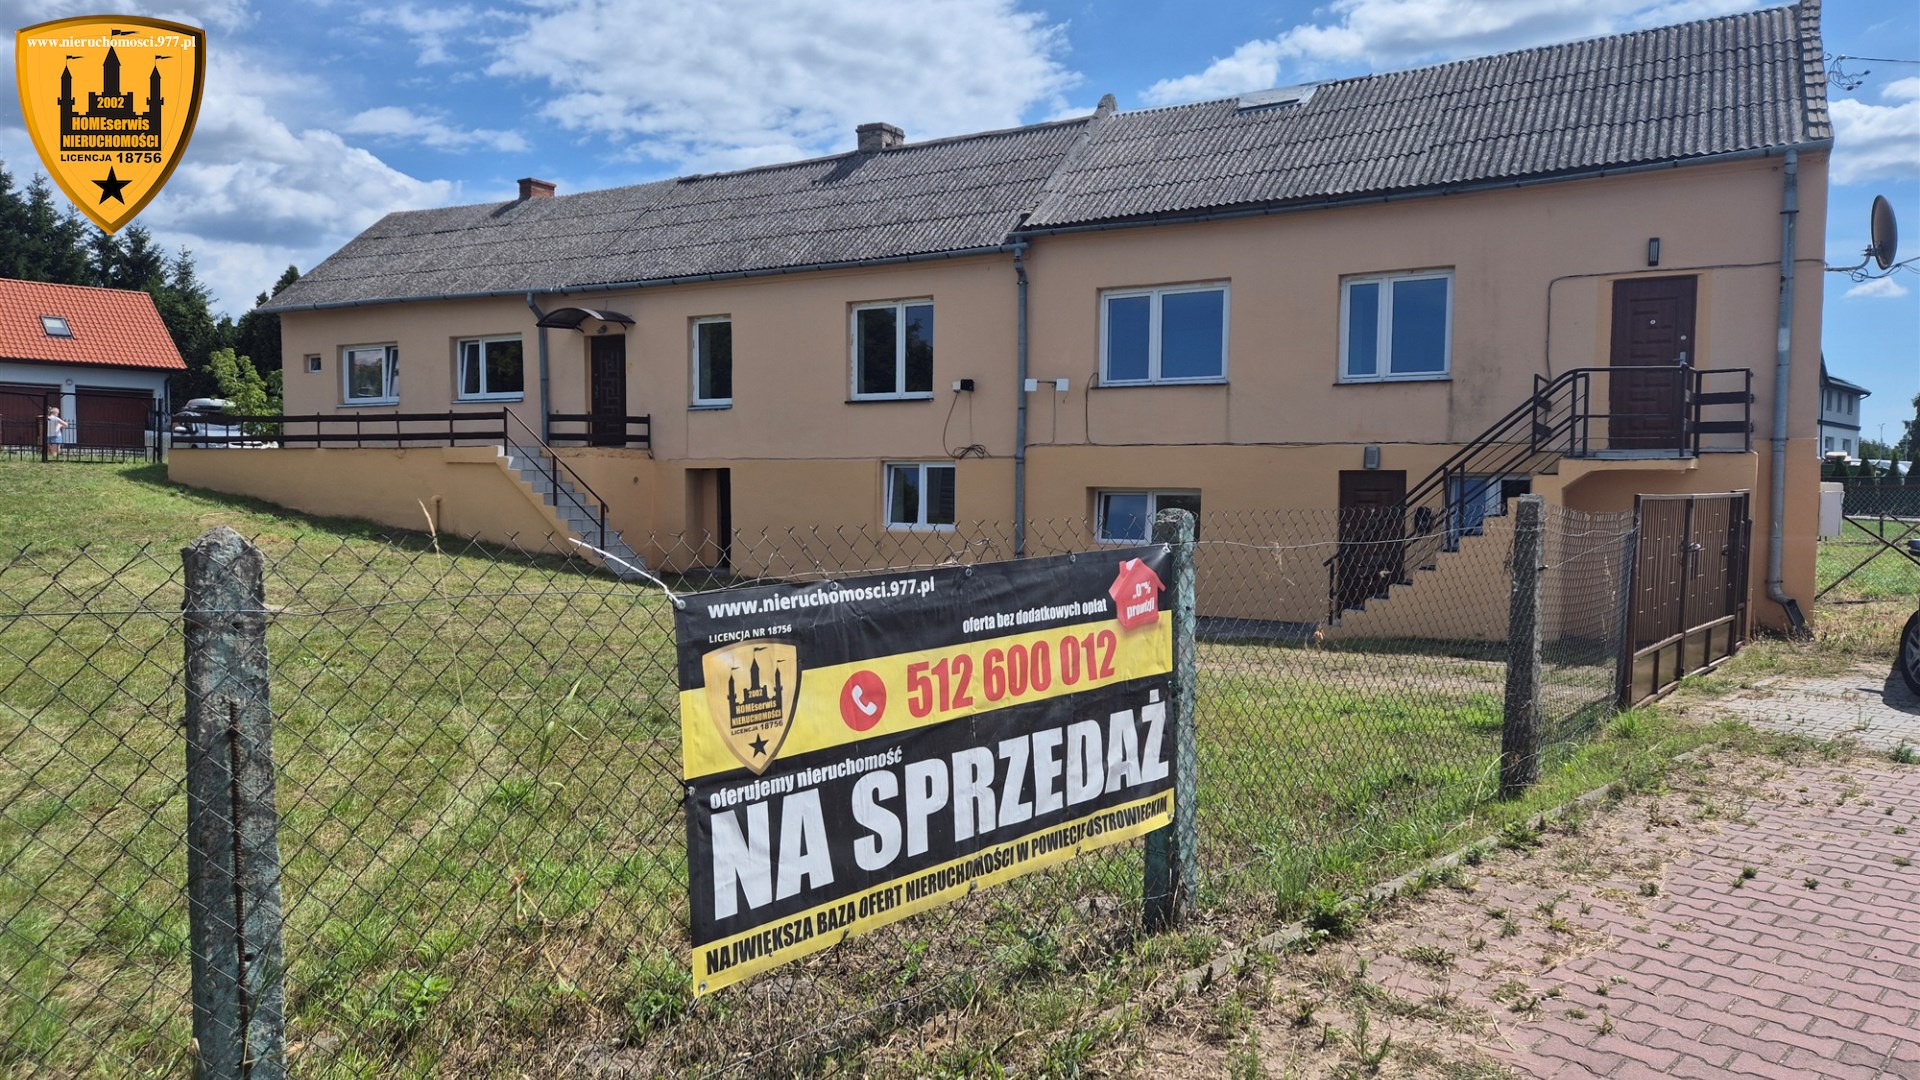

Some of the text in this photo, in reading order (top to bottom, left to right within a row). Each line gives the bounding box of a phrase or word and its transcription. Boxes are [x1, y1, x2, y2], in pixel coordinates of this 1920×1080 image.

[707, 576, 935, 619] www.nieruchomosci.977.pl
[708, 624, 792, 643] LICENCJA NR 18756
[962, 616, 995, 633] oferta
[996, 612, 1015, 628] bez
[1015, 601, 1081, 625] dodatkowych
[907, 629, 1117, 718] 512 600 012
[735, 700, 777, 715] HOMEserwis
[748, 689, 763, 698] 2002
[731, 720, 783, 736] LICENCJA 18756
[709, 746, 902, 809] oferujemy nieruchomość
[710, 689, 1169, 921] NA SPRZEDAŻ
[706, 795, 1167, 975] NAJWIĘKSZA BAZA OFERT NIERUCHOMOŚCI W POWIECIE OSTROWIECKIM
